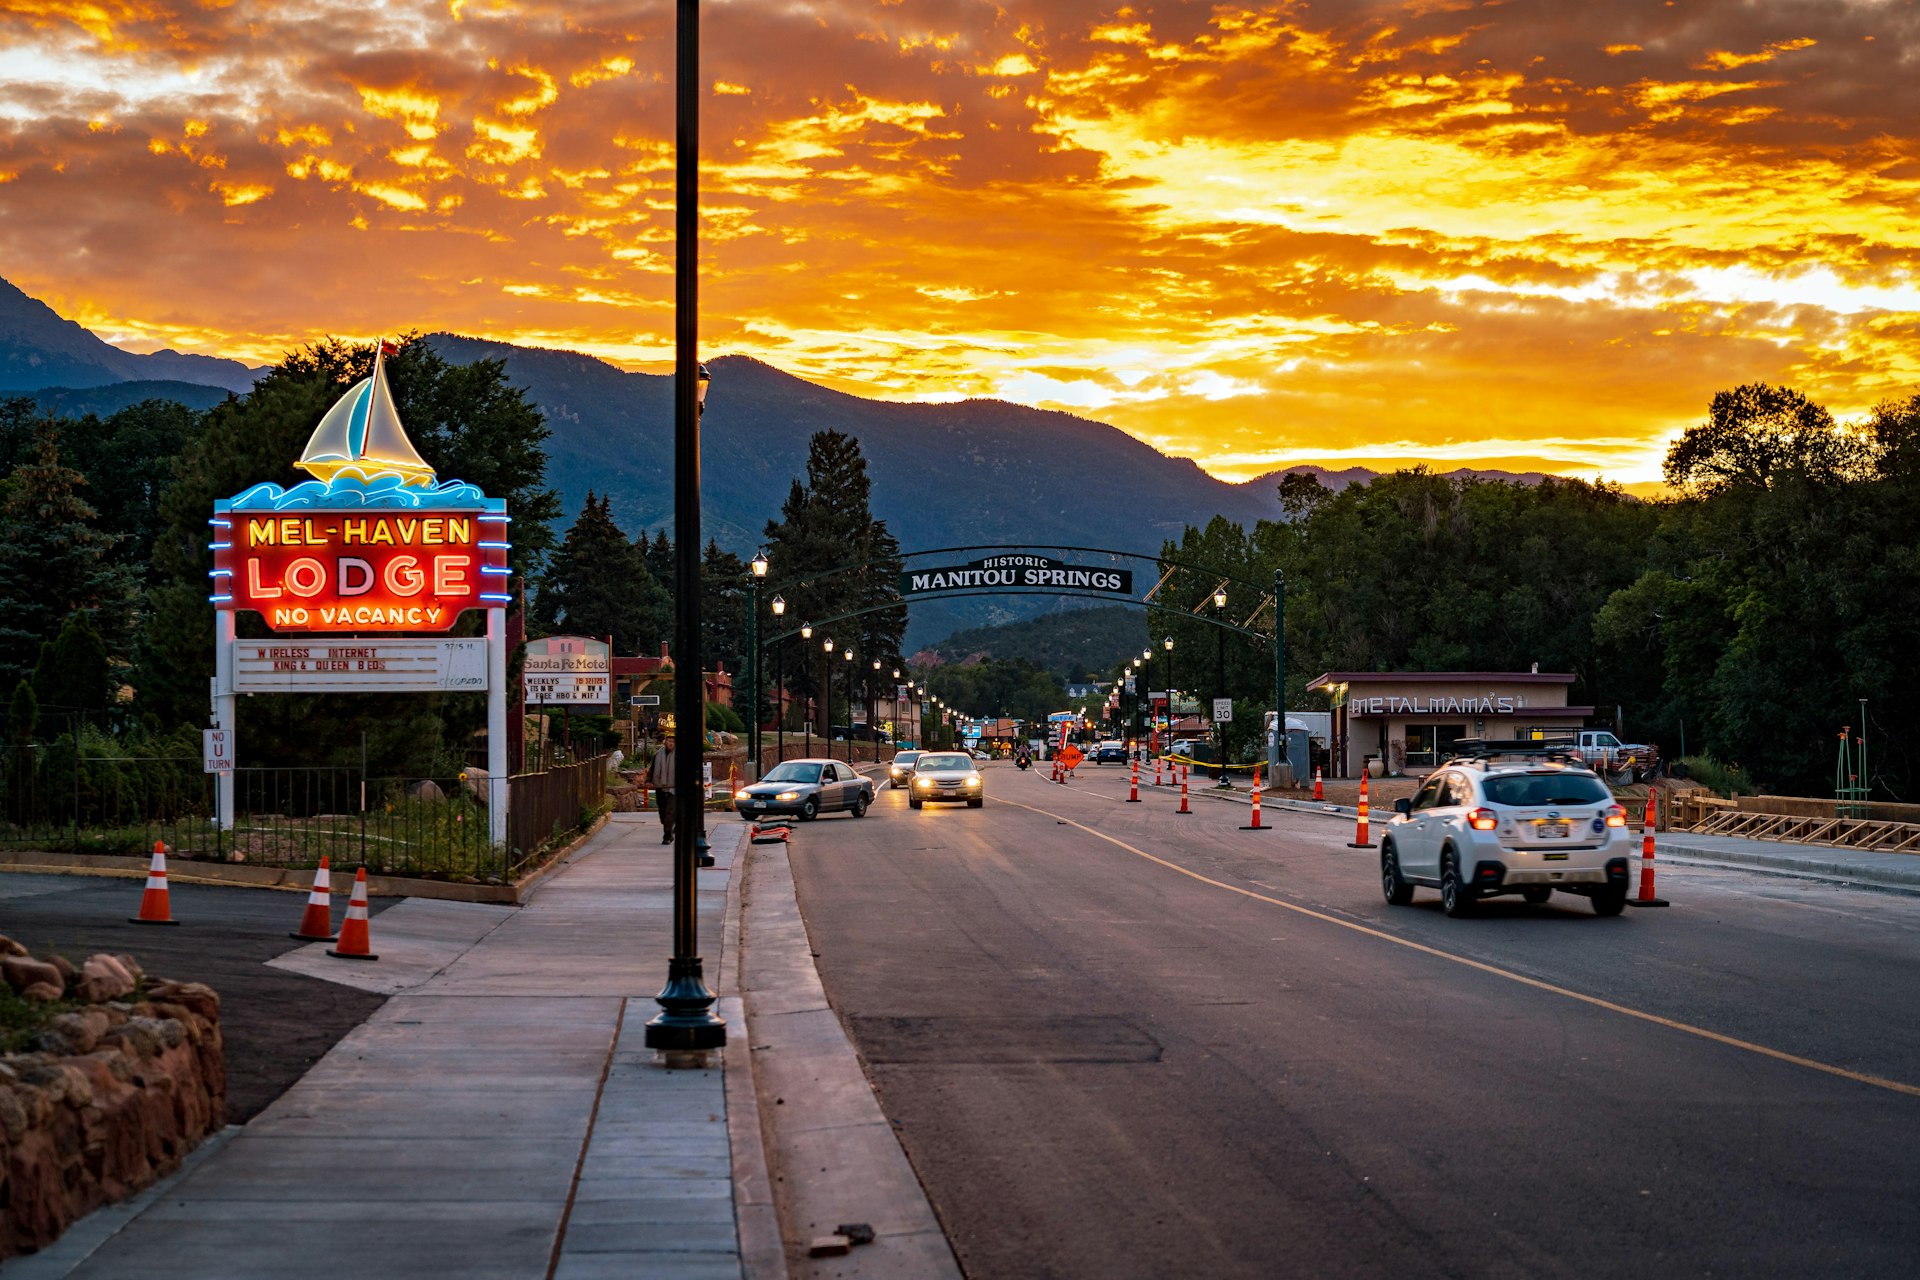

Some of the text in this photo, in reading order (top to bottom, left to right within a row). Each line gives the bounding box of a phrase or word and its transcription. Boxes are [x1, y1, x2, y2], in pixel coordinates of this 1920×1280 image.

[249, 518, 470, 547] MEL-HAVEN
[983, 556, 1048, 568] HISTORIC
[248, 555, 471, 599] LODGE
[911, 569, 1122, 591] MANITOU SPRINGS
[275, 607, 441, 625] NO VACANCY
[257, 648, 377, 658] WIRELESS INTERNET
[274, 660, 386, 670] KING & QUEEN BEDS
[524, 659, 560, 670] Santa
[575, 659, 609, 669] Motel
[1216, 710, 1230, 719] 30
[212, 732, 225, 742] NO
[214, 744, 223, 757] U
[208, 759, 231, 769] TURN
